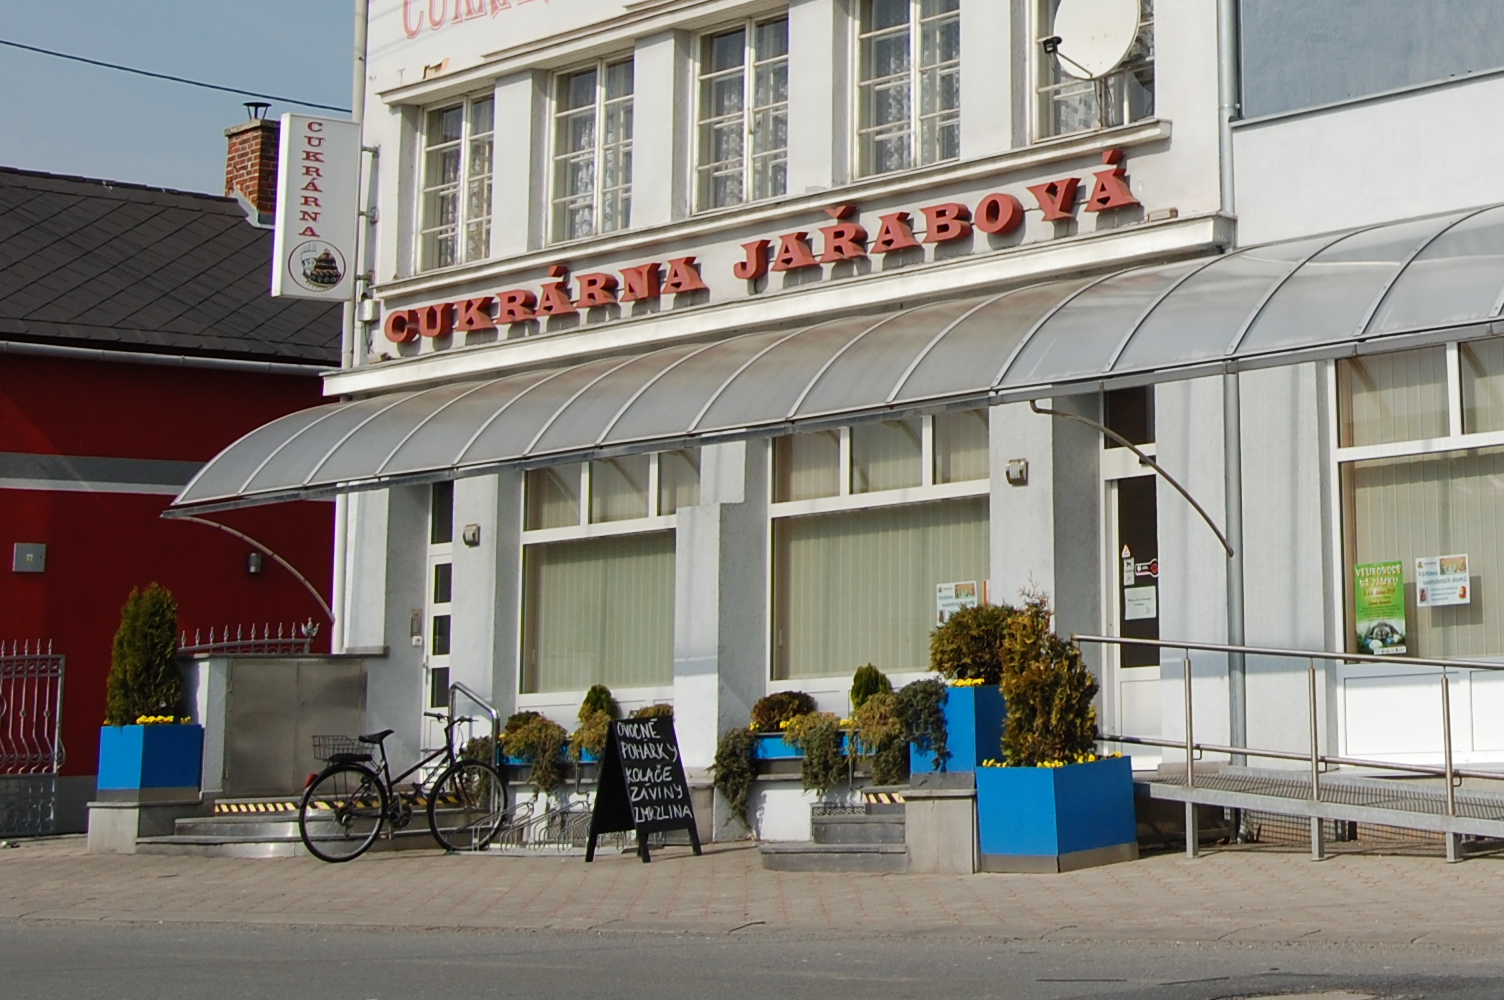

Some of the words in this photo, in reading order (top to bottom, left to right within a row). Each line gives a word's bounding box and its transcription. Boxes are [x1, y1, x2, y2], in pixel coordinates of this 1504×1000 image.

[298, 121, 325, 238] CUKRÁRNA
[384, 256, 709, 343] CUKRÁRNA
[733, 149, 1140, 280] JAŘABOVÁ
[616, 718, 660, 740] OVOCNÉ
[620, 739, 678, 762] POHÁRKY
[629, 782, 683, 802] ZÁVINY
[633, 804, 693, 823] ZMRZLINA
